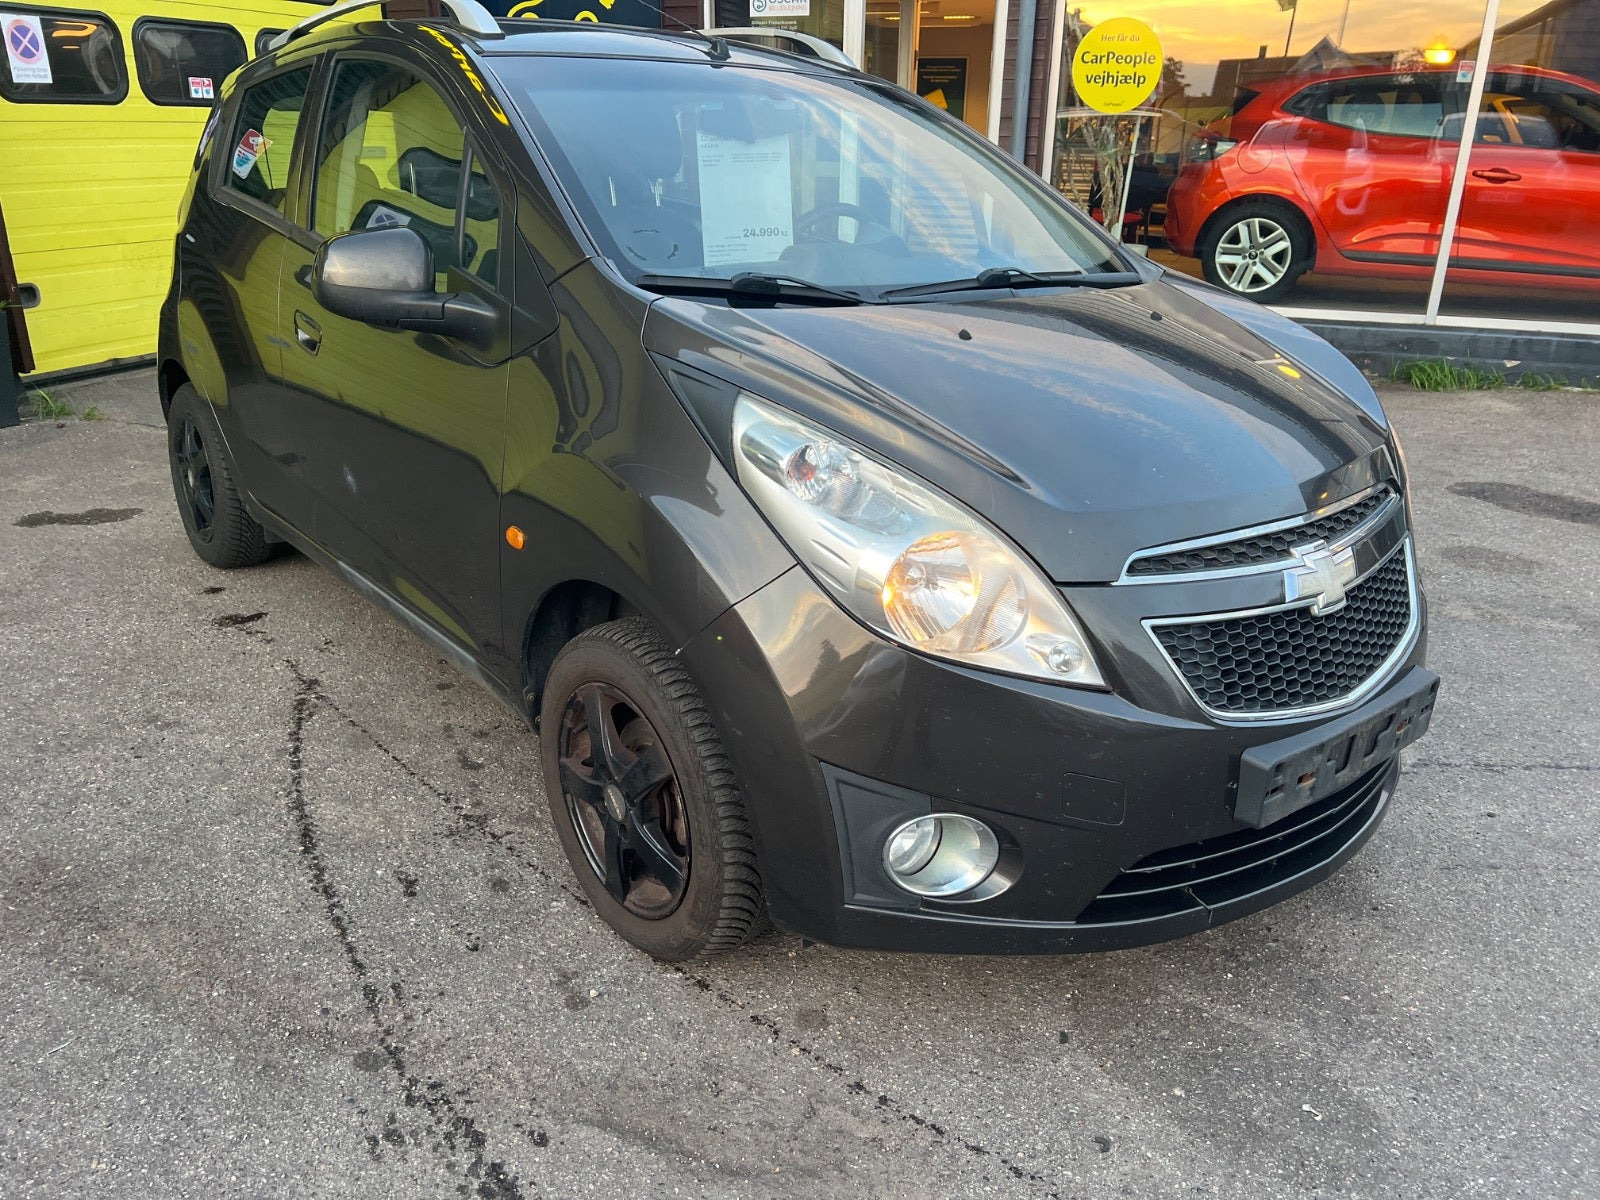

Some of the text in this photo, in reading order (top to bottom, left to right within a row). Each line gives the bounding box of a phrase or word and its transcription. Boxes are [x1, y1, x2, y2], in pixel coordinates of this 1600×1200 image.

[1100, 33, 1140, 42] Her får du
[1081, 51, 1156, 68] CarPeople
[1085, 70, 1147, 88] vejhjælp
[742, 226, 780, 238] 24.990
